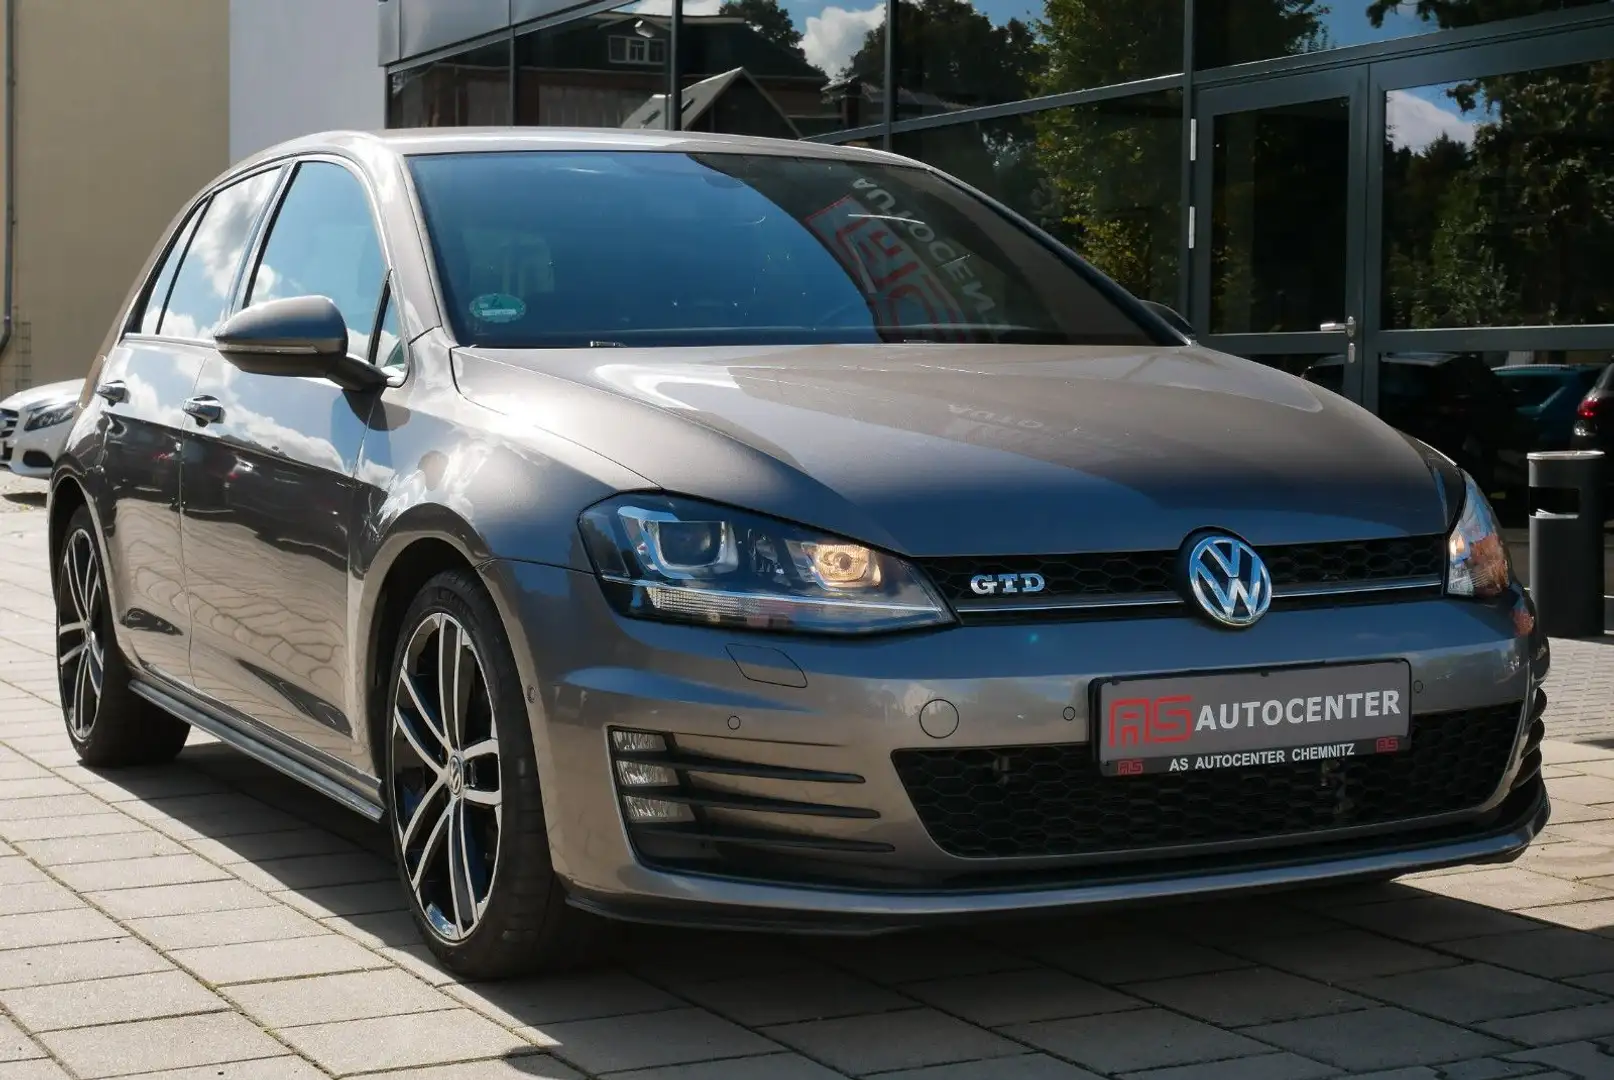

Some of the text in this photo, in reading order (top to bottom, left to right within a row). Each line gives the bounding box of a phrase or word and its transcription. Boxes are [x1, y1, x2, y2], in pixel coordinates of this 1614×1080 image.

[970, 573, 1045, 595] GTD
[1109, 690, 1401, 747] AS AUTOCENTER
[1169, 743, 1355, 772] AS AUTOCENTER CHEMNITZ
